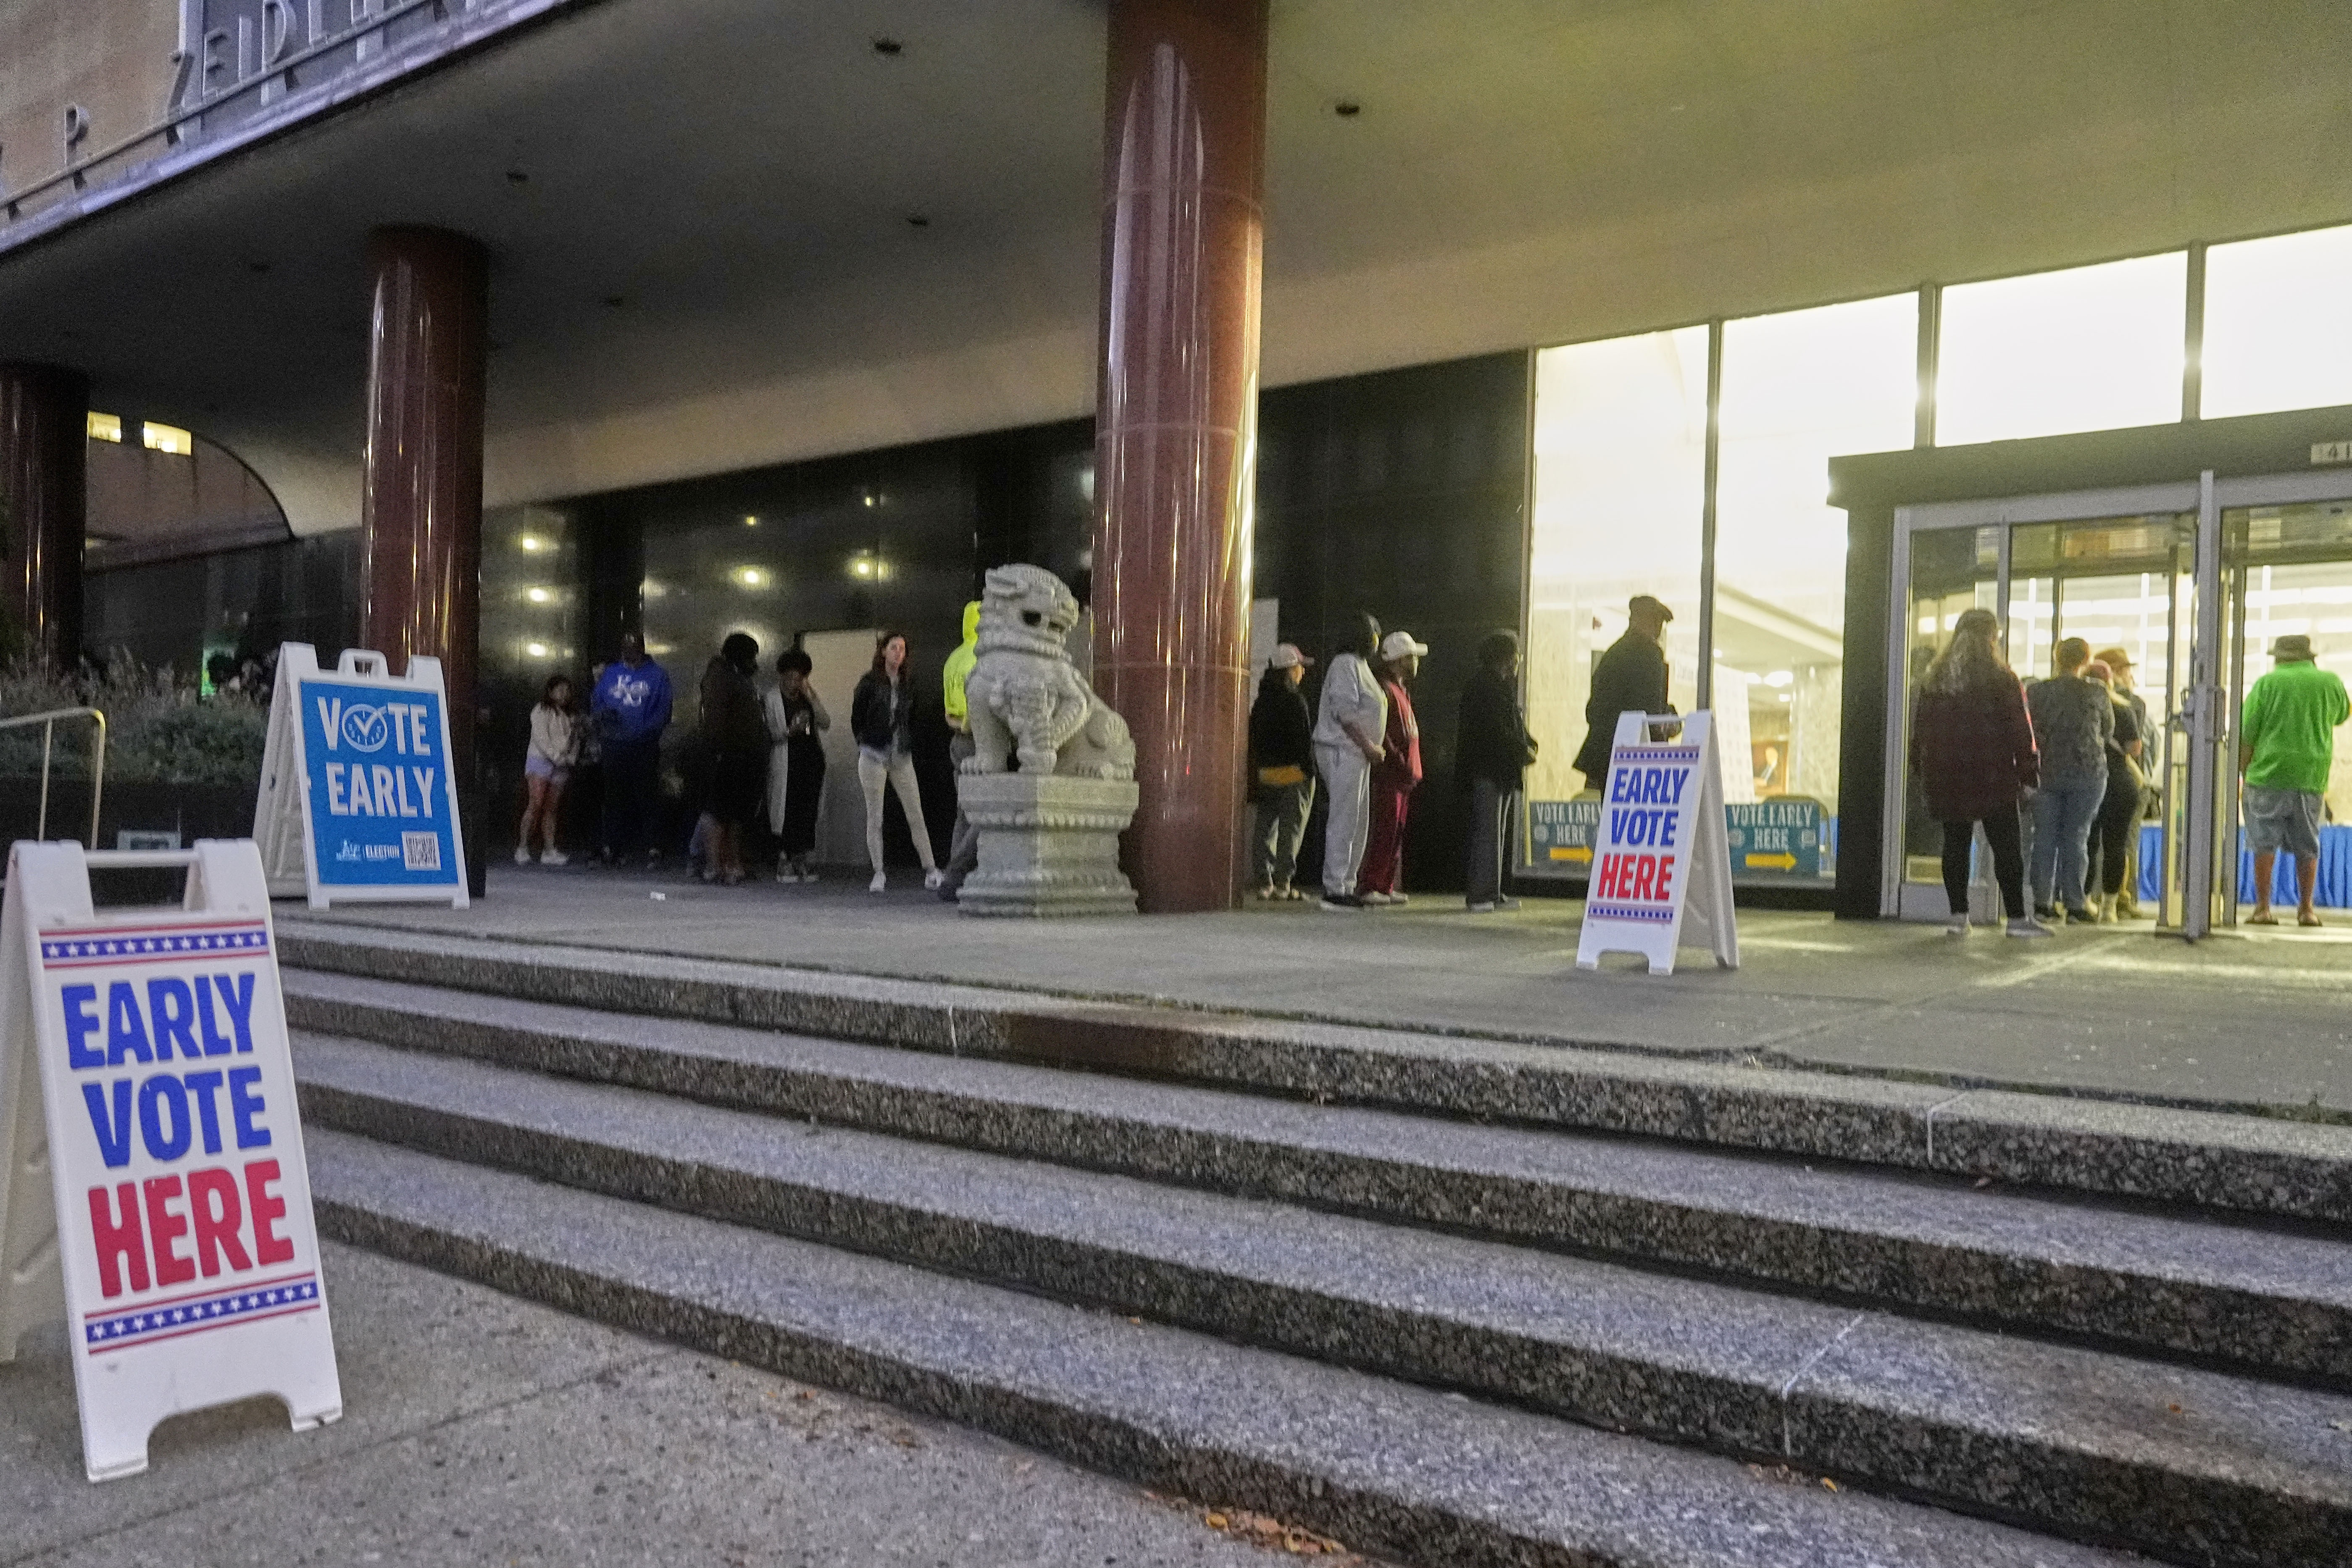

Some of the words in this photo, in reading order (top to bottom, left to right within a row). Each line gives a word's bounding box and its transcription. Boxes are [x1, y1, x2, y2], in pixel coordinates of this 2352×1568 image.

[317, 697, 431, 756] VOTE
[326, 762, 434, 818] EARLY
[1611, 768, 1689, 804] EARLY
[1536, 803, 1565, 823] VOTE
[1612, 808, 1678, 847] VOTE
[1731, 805, 1765, 826] VOTE
[1769, 804, 1812, 827] EARLY
[1557, 825, 1586, 846] HERE
[1754, 828, 1789, 850] HERE
[1597, 852, 1675, 902] HERE
[61, 972, 255, 1069] EARLY
[82, 1065, 271, 1169] VOTE
[87, 1158, 295, 1300] HERE
